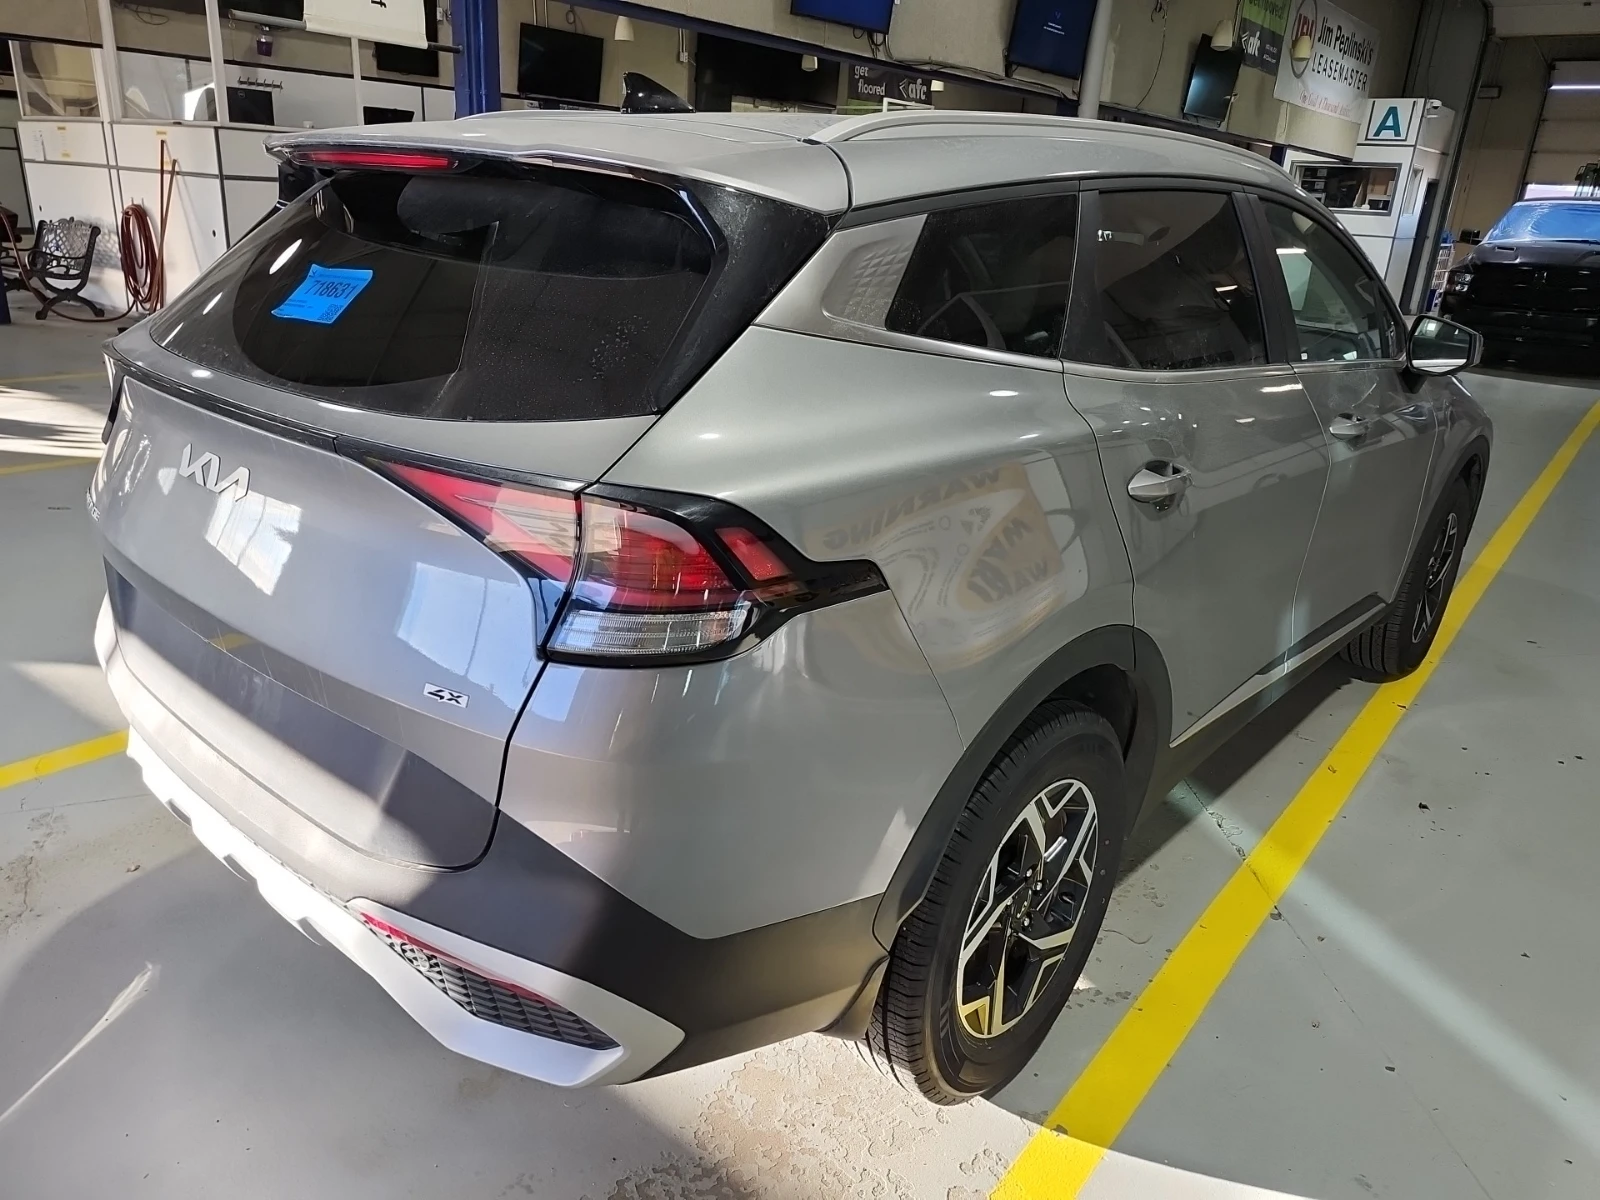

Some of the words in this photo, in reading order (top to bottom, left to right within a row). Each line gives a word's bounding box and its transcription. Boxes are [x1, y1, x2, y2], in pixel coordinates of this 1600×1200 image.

[1317, 16, 1333, 48] Jim
[1333, 25, 1374, 66] Peplinski's
[854, 65, 869, 78] get
[858, 79, 886, 96] floored
[1311, 52, 1368, 91] LEASEMASTER
[1373, 106, 1402, 138] A
[304, 280, 359, 300] 718631
[179, 443, 250, 503] KIA
